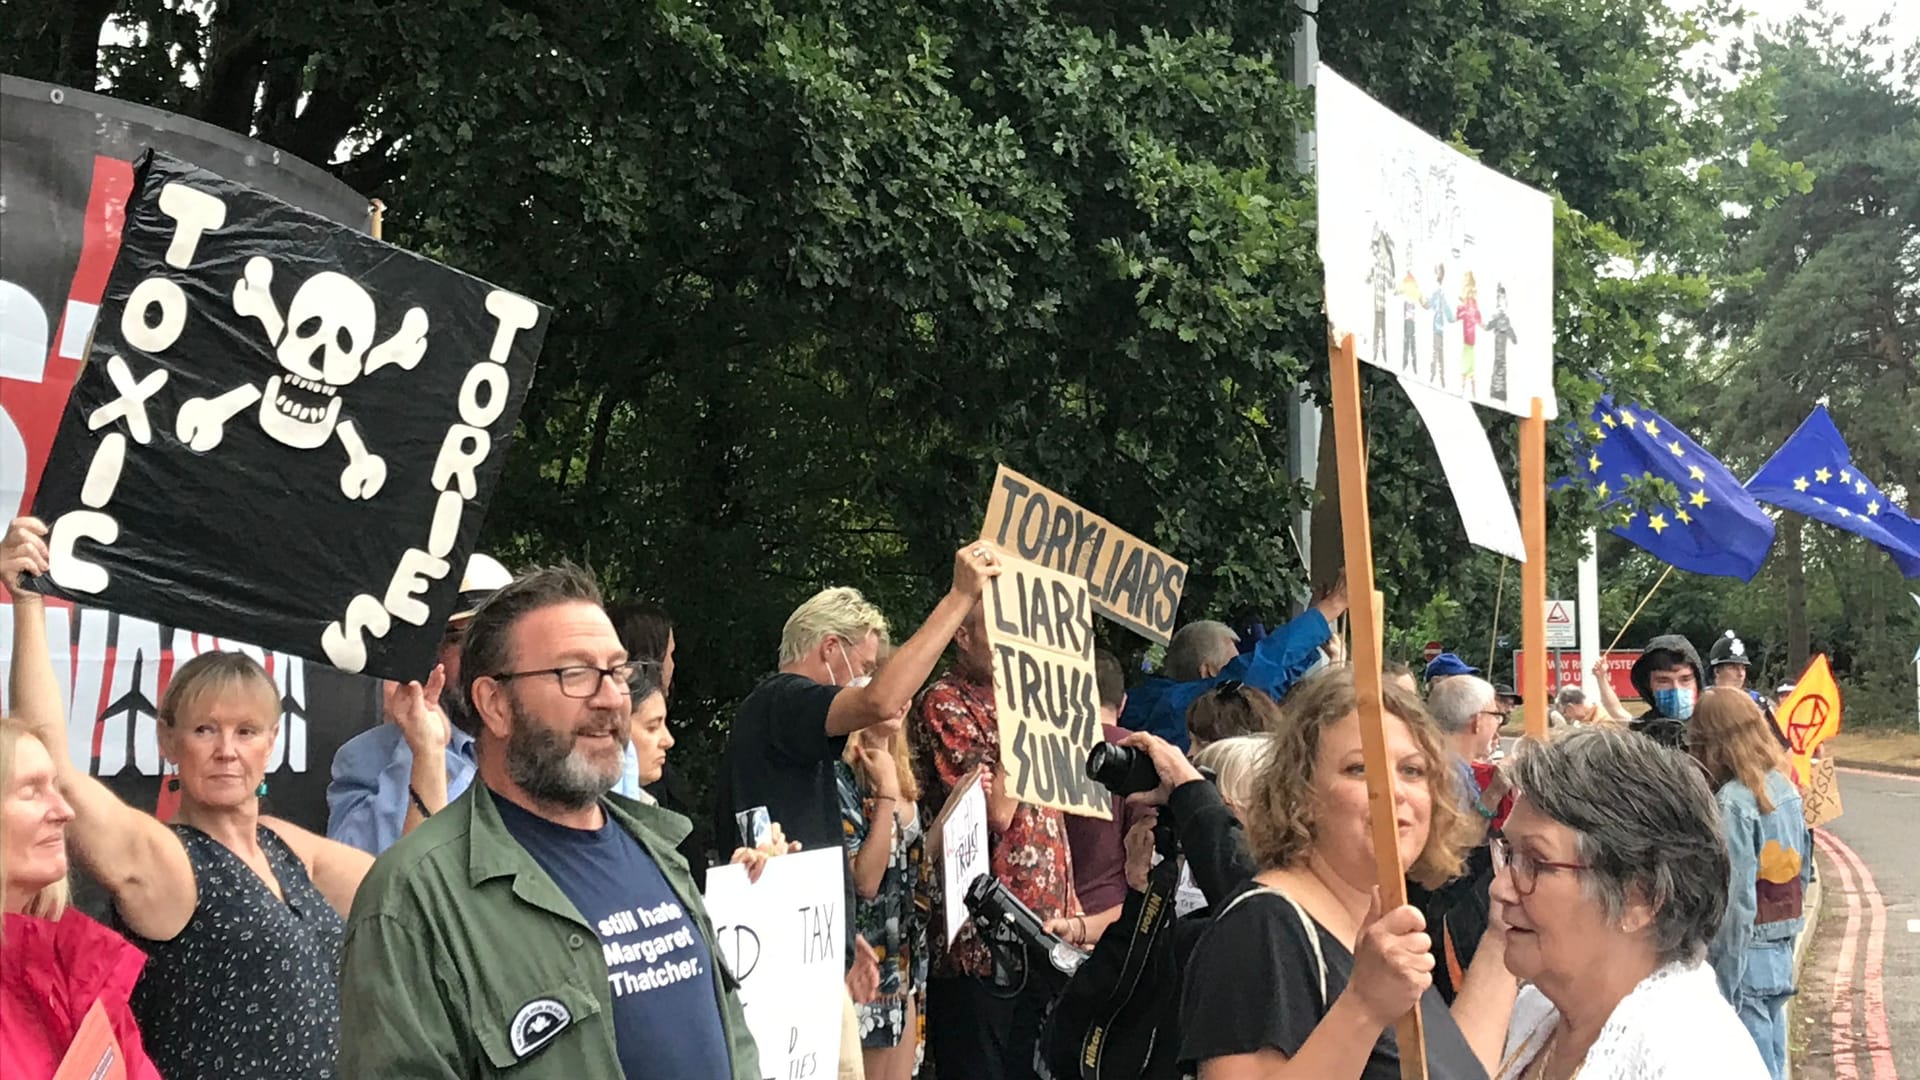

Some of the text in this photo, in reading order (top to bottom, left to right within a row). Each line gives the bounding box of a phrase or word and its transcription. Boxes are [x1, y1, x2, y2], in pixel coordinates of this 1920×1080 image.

[49, 183, 227, 594] TOXIC
[321, 290, 539, 674] TORIES
[1000, 475, 1182, 632] TORY LIARS
[990, 571, 1095, 661] LIARS
[995, 643, 1096, 749] TRUSS
[598, 901, 683, 937] still hate
[798, 902, 834, 964] TAX
[1140, 892, 1163, 934] Nikon
[602, 925, 695, 967] Margaret
[608, 957, 703, 997] Thatcher.
[1085, 1026, 1104, 1068] Nikon
